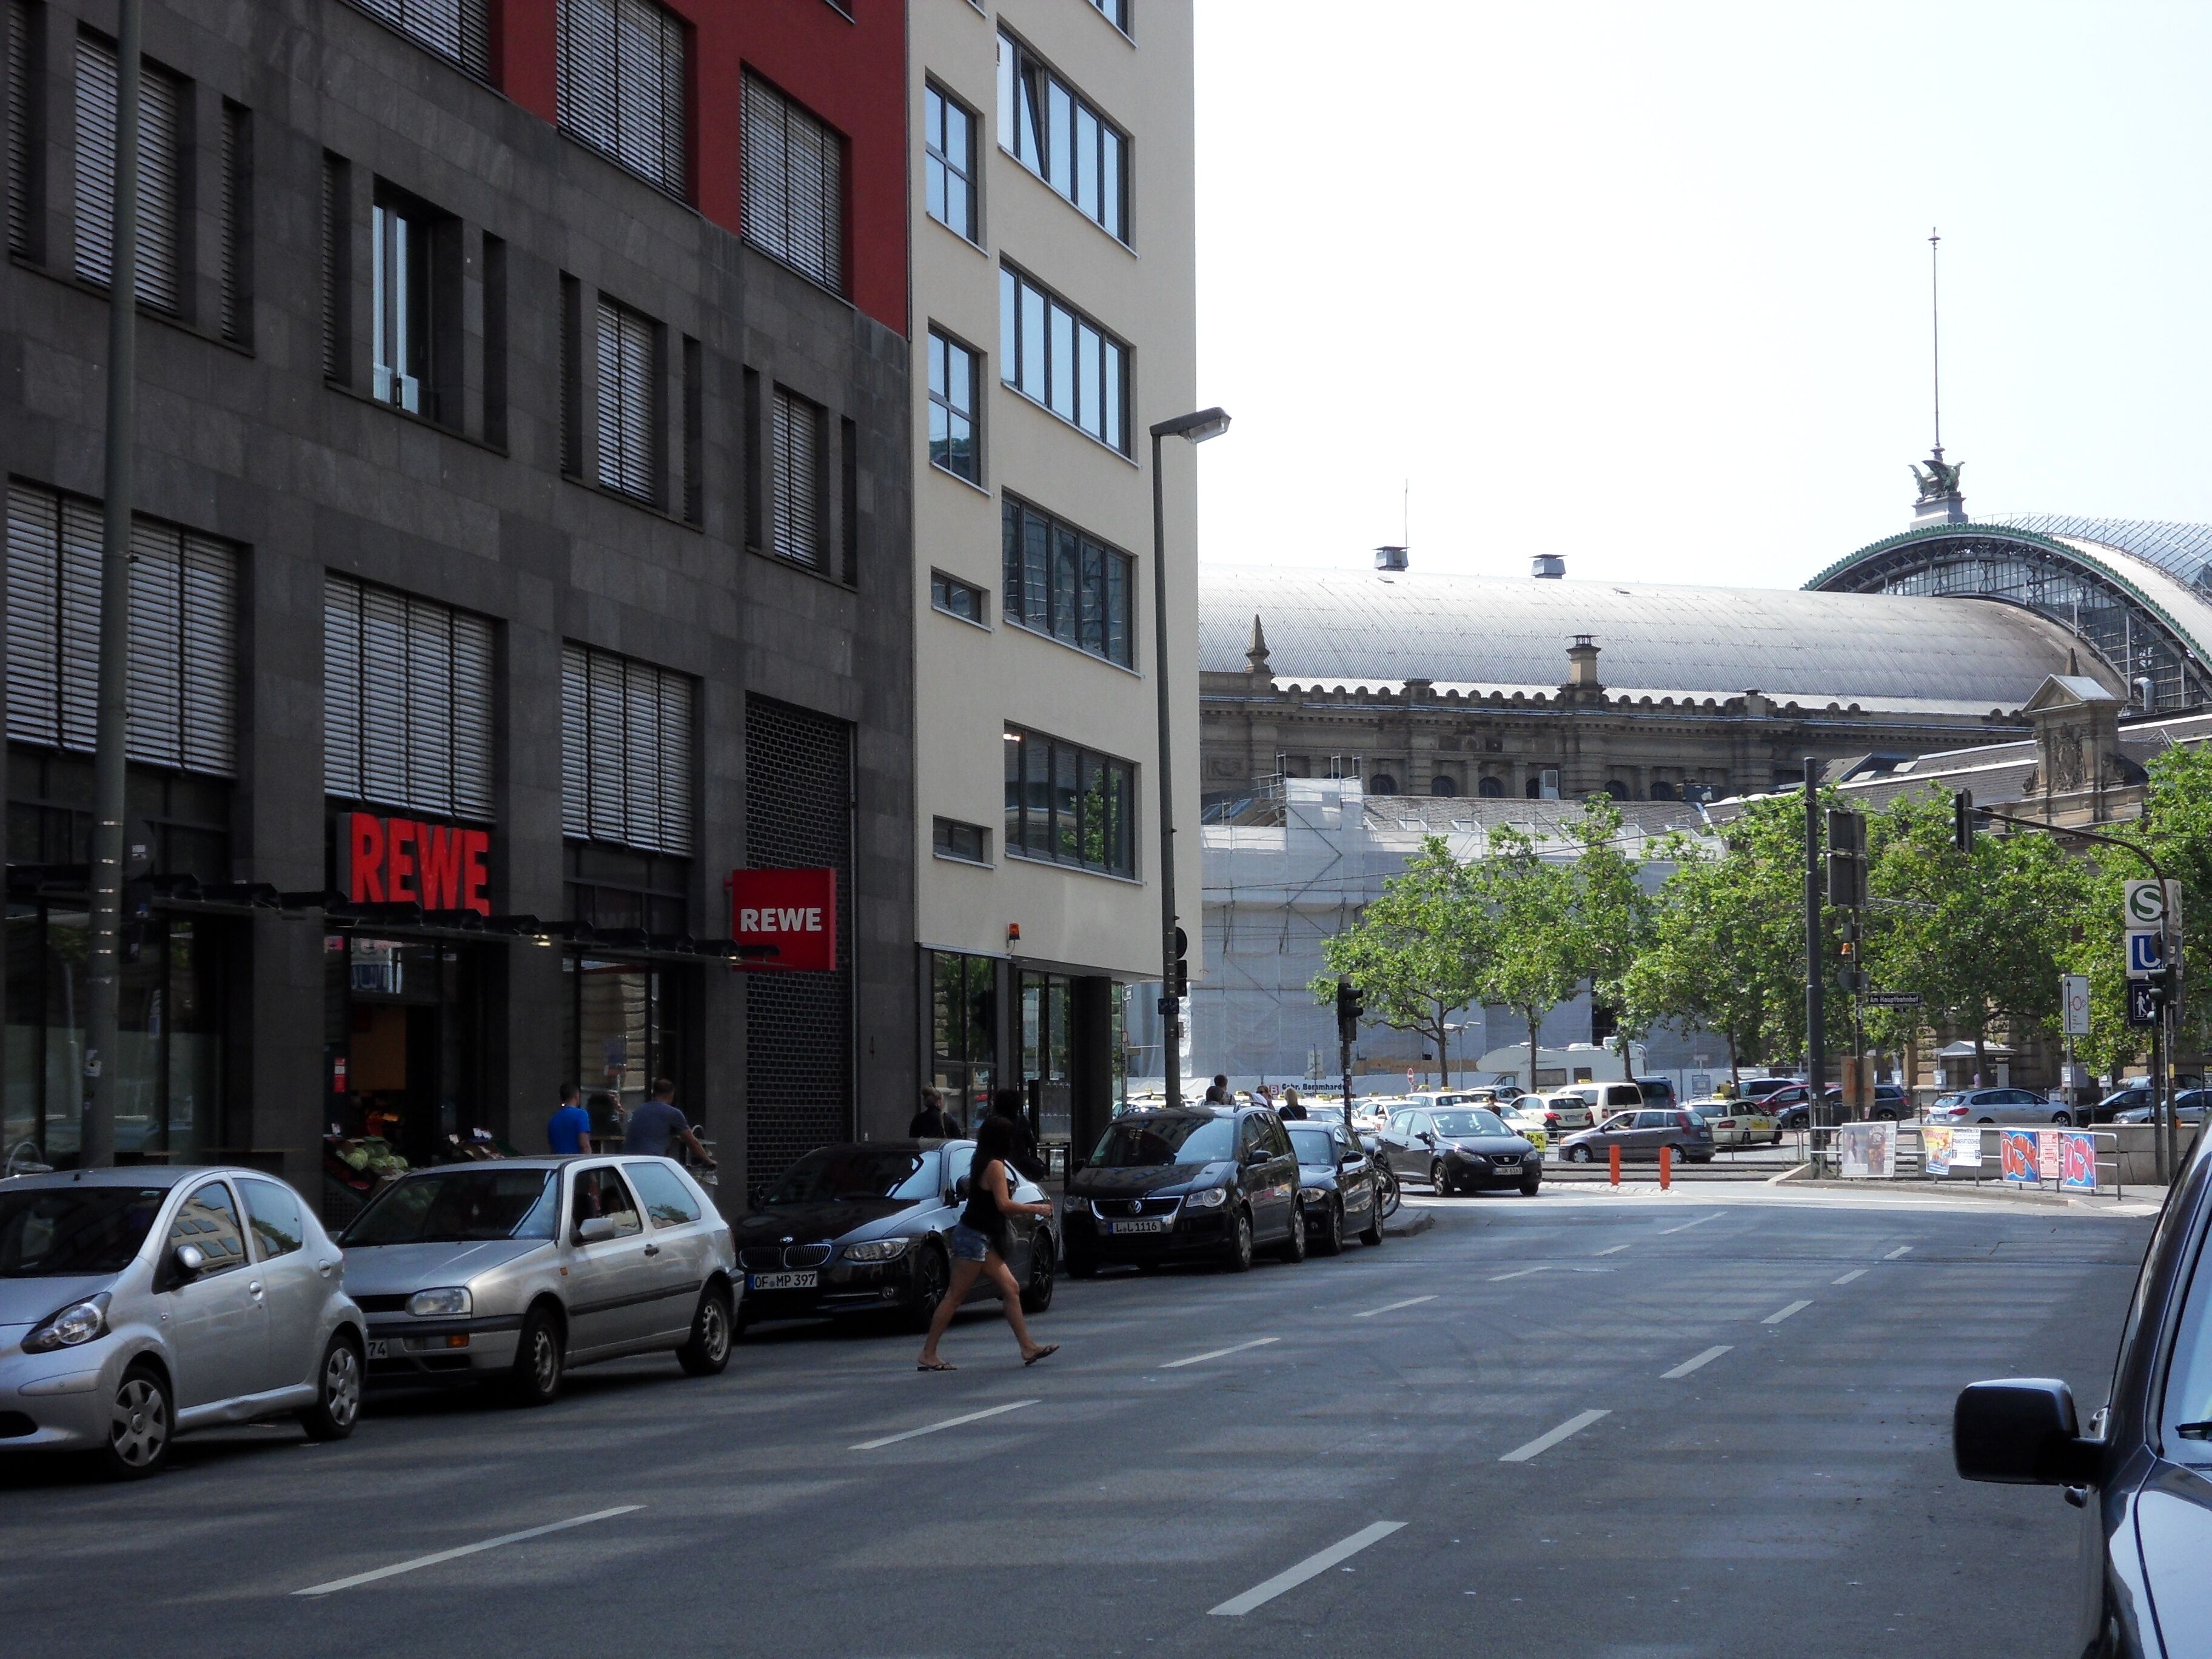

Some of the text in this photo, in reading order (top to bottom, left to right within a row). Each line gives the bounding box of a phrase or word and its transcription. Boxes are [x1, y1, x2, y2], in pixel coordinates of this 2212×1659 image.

[350, 812, 490, 917] REWE
[2136, 888, 2163, 919] S
[740, 908, 822, 932] REWE
[1880, 996, 1919, 1004] Hauptbahnhof
[1116, 1222, 1157, 1232] L L 1116
[755, 1273, 816, 1288] OF MP 397
